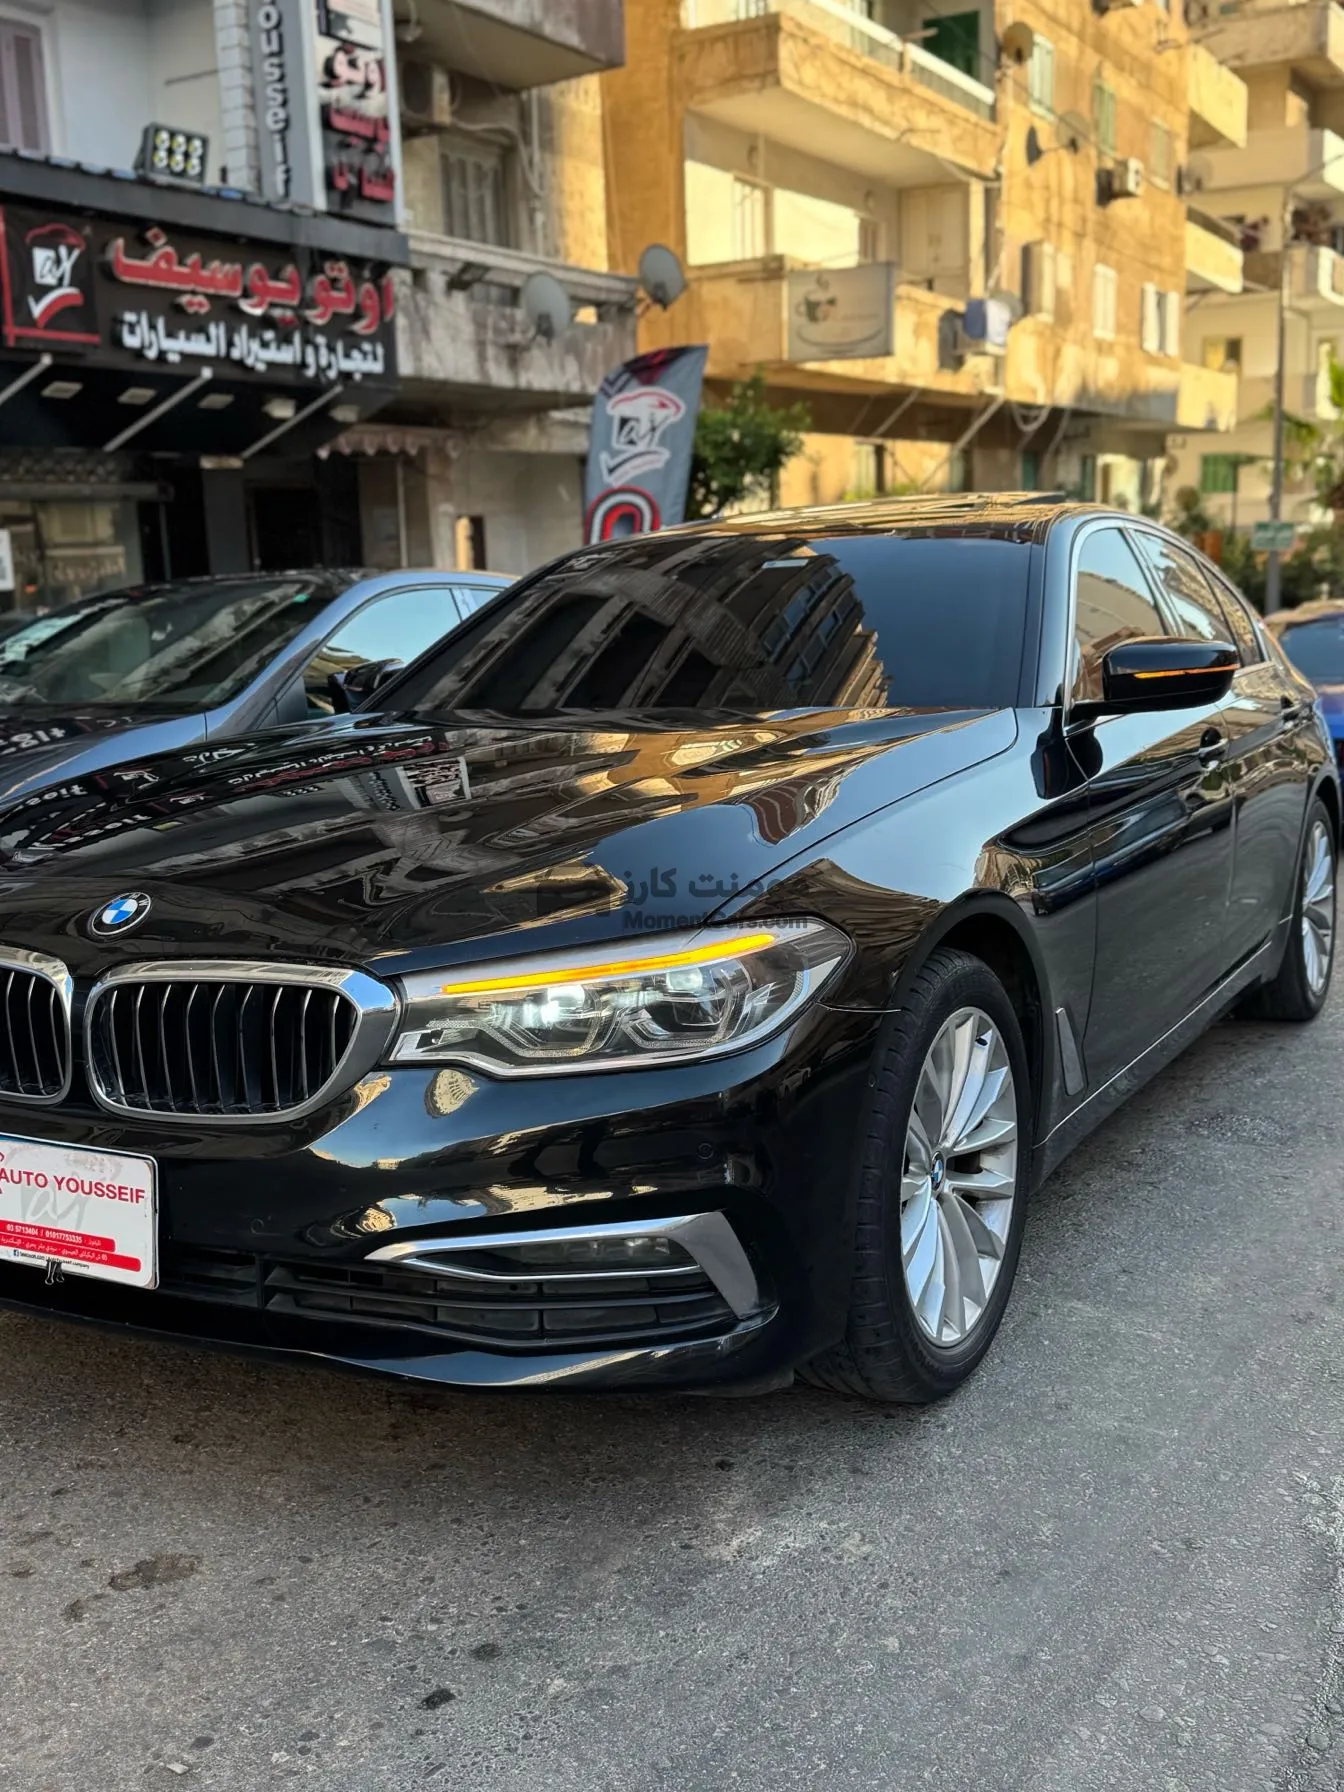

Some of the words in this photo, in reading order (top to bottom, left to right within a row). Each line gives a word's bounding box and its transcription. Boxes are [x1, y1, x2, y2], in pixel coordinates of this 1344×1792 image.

[258, 0, 292, 198] ousseif
[110, 226, 301, 327] يوسيف
[122, 309, 227, 363] السيارات
[230, 323, 302, 372] استيراد
[315, 335, 384, 381] لتجارة
[303, 344, 317, 378] و
[0, 1168, 48, 1188] AUTO
[53, 1175, 146, 1204] YOUSSEIF
